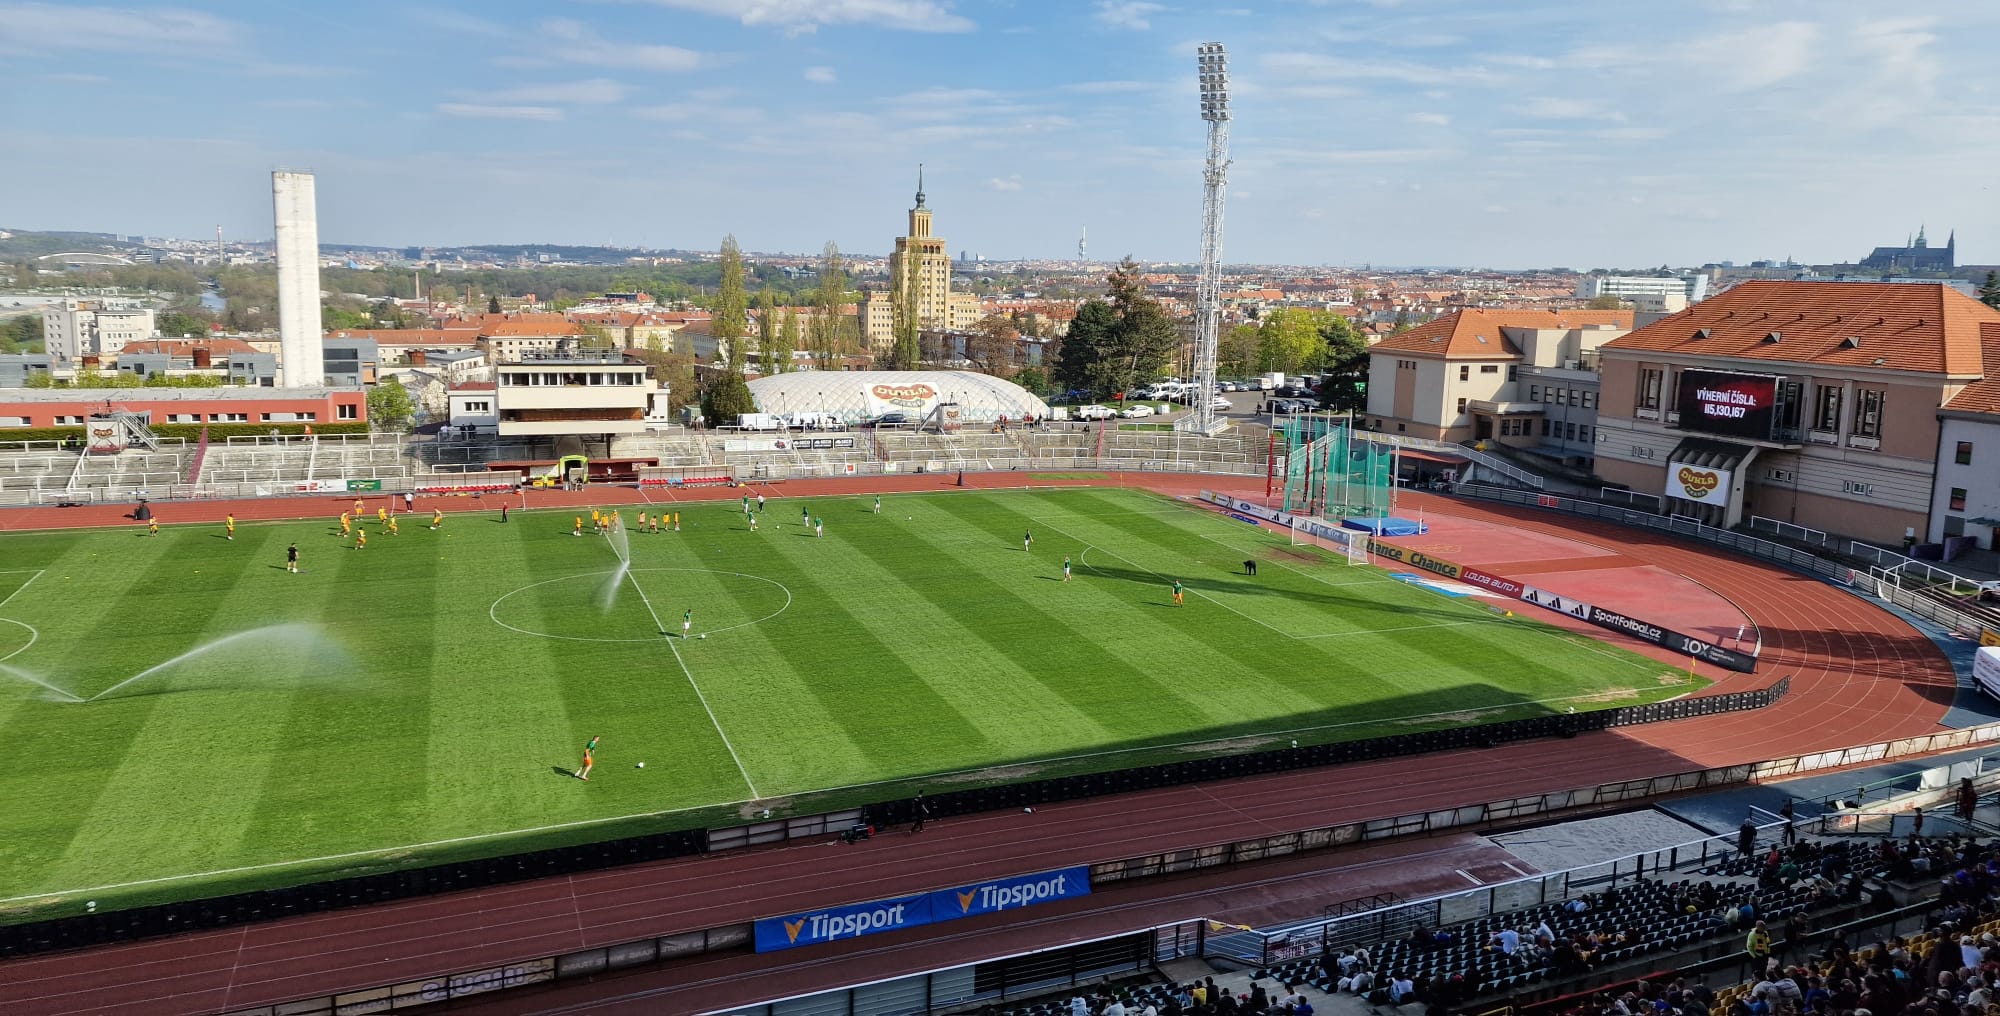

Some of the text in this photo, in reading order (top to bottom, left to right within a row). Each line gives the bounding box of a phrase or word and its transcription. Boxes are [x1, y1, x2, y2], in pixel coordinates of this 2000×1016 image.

[1696, 387, 1757, 406] VÝHERNÍ ČÍSLA:
[1704, 403, 1746, 418] 115,130,167
[1680, 471, 1715, 485] DUKLA
[1410, 552, 1457, 577] Chance
[1594, 609, 1662, 638] SportFotbal.cz
[981, 874, 1066, 910] Tipsport
[809, 903, 905, 941] Tipsport
